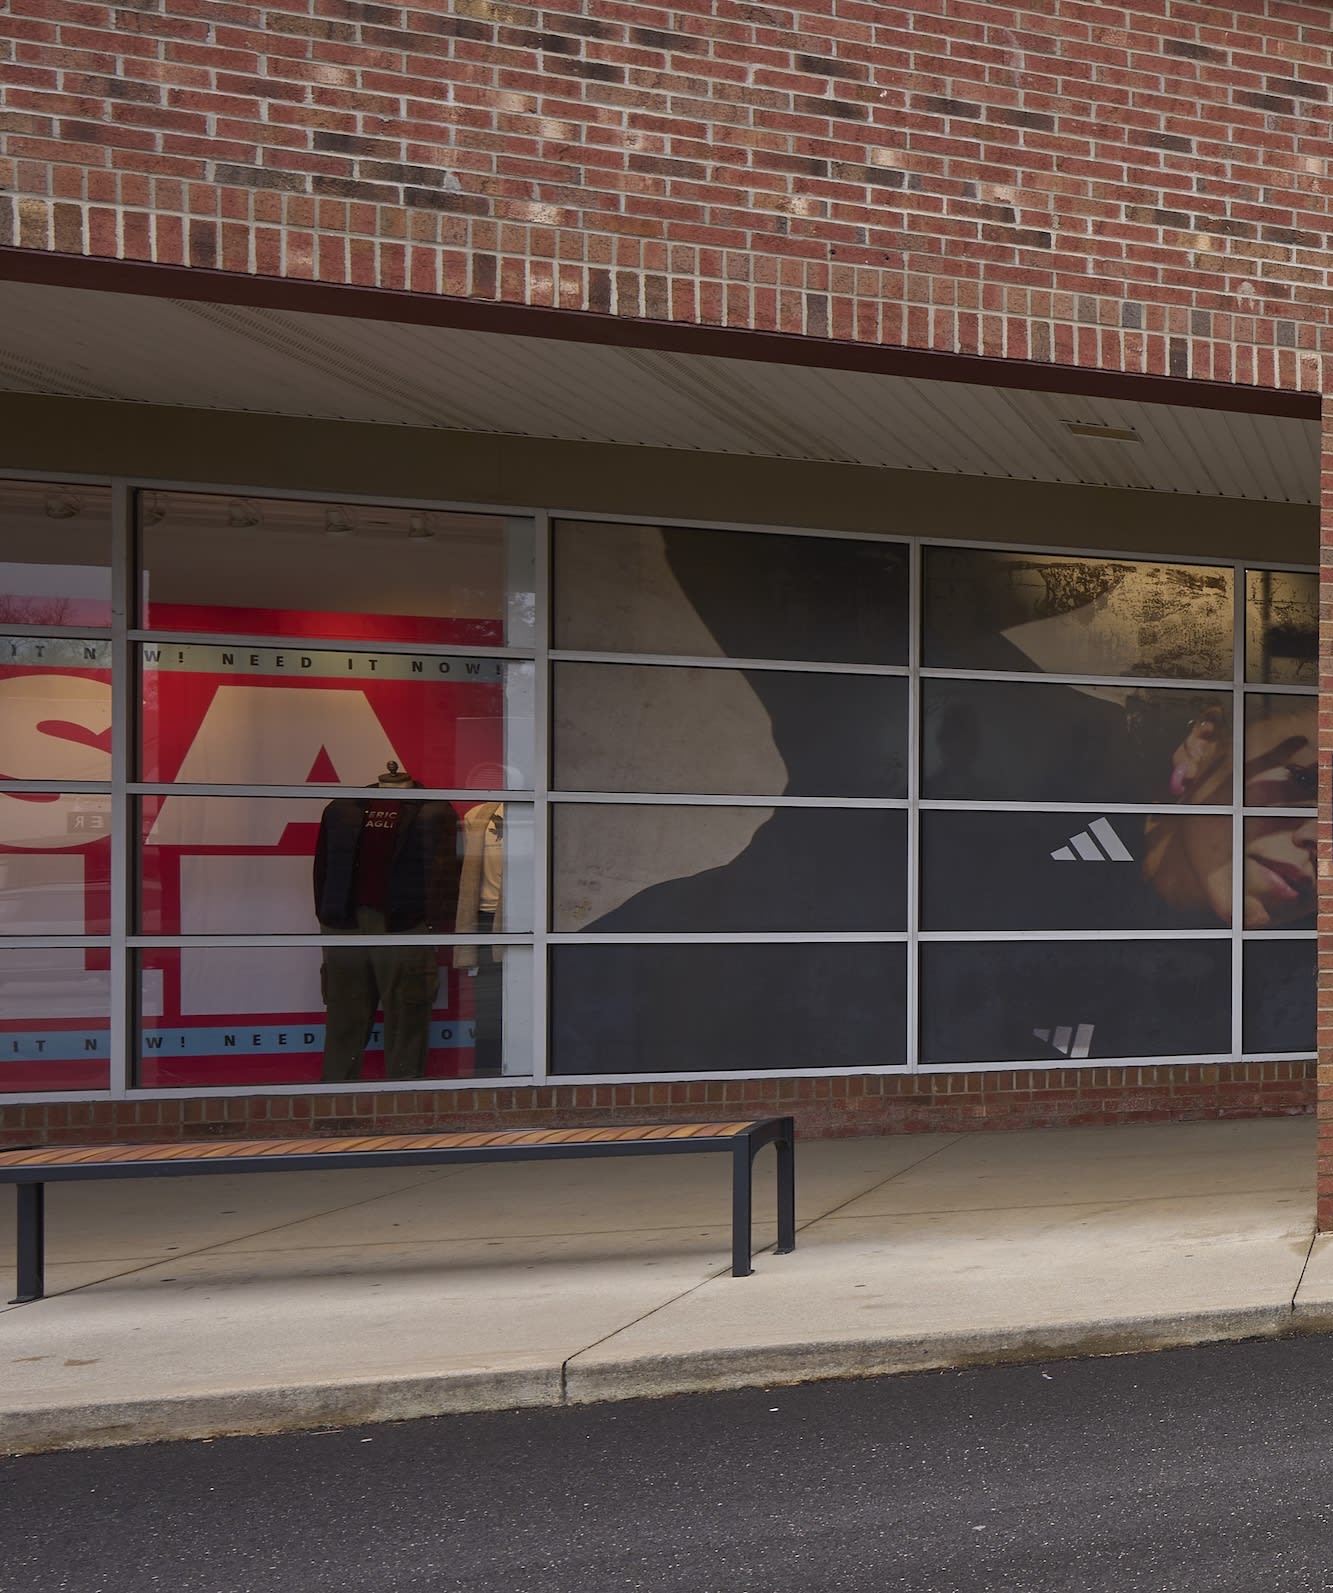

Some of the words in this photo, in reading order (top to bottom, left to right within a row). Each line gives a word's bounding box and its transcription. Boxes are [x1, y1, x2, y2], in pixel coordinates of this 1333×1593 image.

[84, 647, 184, 663] NW!
[222, 653, 312, 669] NEED
[348, 658, 378, 671] IT
[13, 1040, 46, 1052] IT
[85, 1036, 186, 1050] NW!
[224, 1032, 315, 1047] NEED
